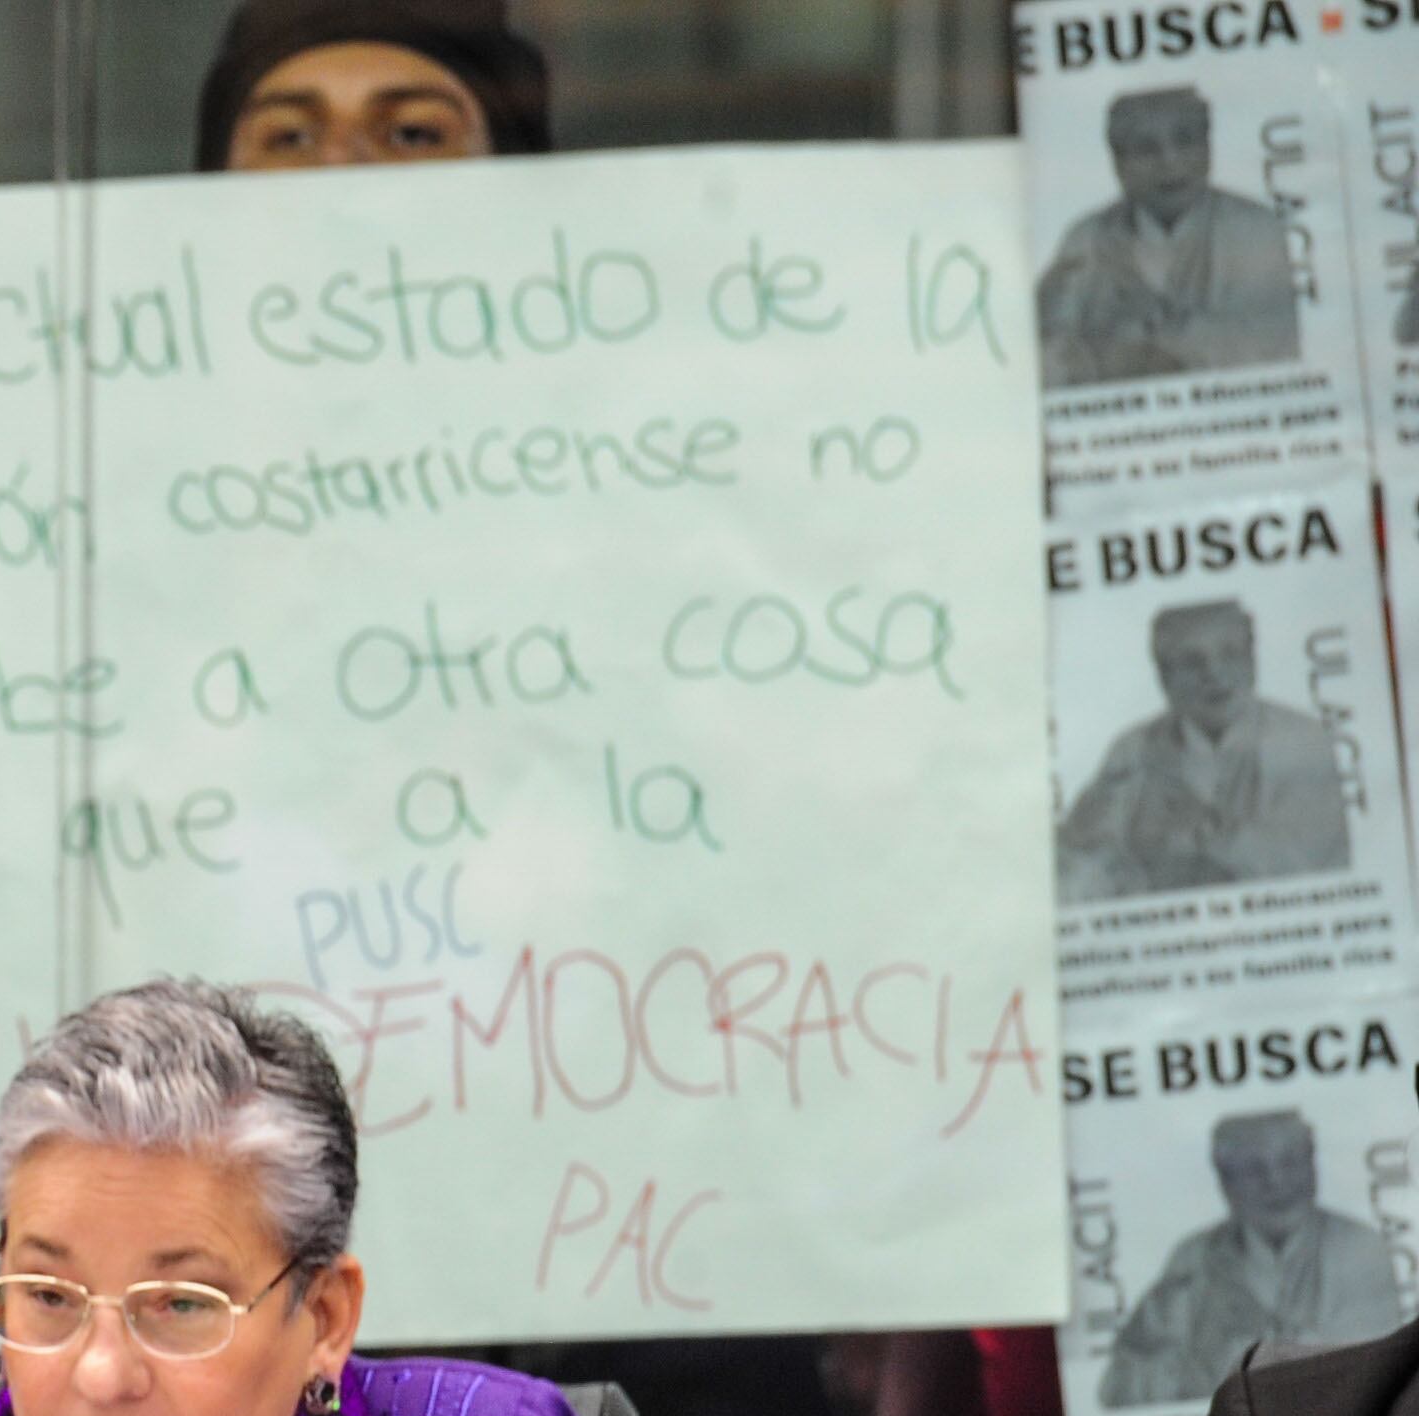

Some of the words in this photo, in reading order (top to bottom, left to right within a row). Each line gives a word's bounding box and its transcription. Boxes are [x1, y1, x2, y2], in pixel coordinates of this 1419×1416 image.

[1055, 0, 1299, 69] BUSCA
[248, 226, 663, 366] estado
[707, 232, 849, 346] de
[903, 232, 1011, 368] la
[166, 412, 743, 536] costarricense
[808, 412, 923, 485] no
[1100, 506, 1341, 587] BUSCA
[191, 644, 271, 729] a
[335, 598, 597, 723] otra
[661, 582, 969, 703] cosa
[61, 784, 243, 930] que
[395, 765, 491, 848] a
[603, 740, 726, 855] la
[293, 862, 485, 994] PUSC
[1063, 1047, 1140, 1102] SE
[1158, 1018, 1403, 1094] BUSCA
[533, 1160, 727, 1312] PAC
